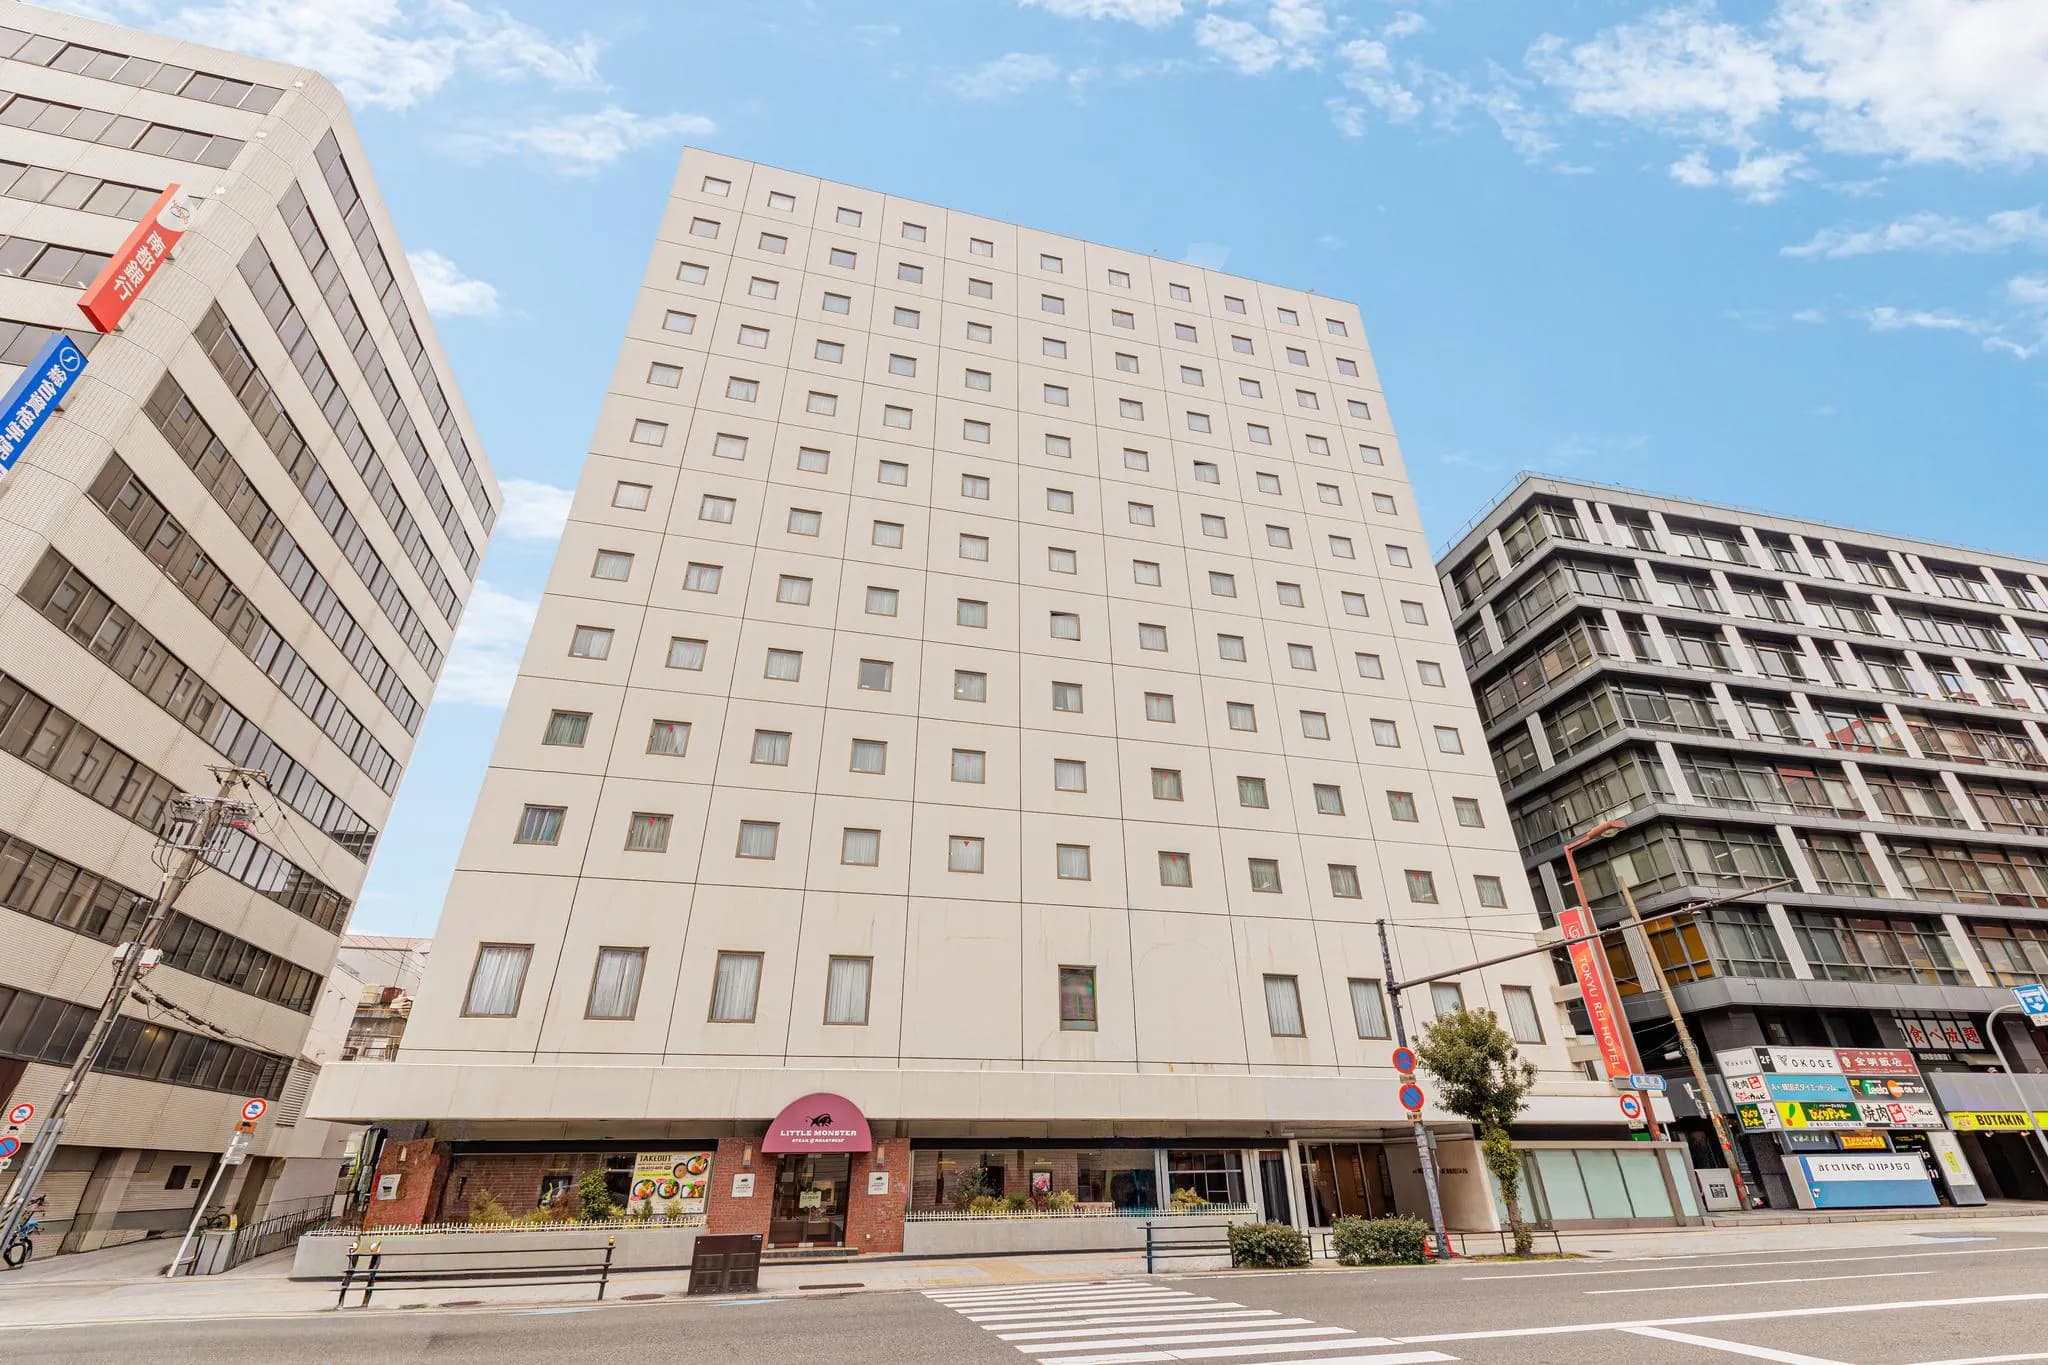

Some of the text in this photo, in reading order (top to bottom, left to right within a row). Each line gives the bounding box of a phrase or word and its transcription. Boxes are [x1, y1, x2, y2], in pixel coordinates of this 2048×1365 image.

[113, 230, 166, 301] 南都銀行
[1579, 956, 1620, 1069] TOKYU REI HOTEL
[1910, 1024, 1982, 1044] 食べ放題
[1760, 1055, 1771, 1065] 2F
[1861, 1104, 1891, 1122] 焼肉
[1976, 1114, 2026, 1126] BUTAKIN
[779, 1129, 857, 1137] LITTLE MONSTER
[639, 1154, 672, 1162] TAKEOUT
